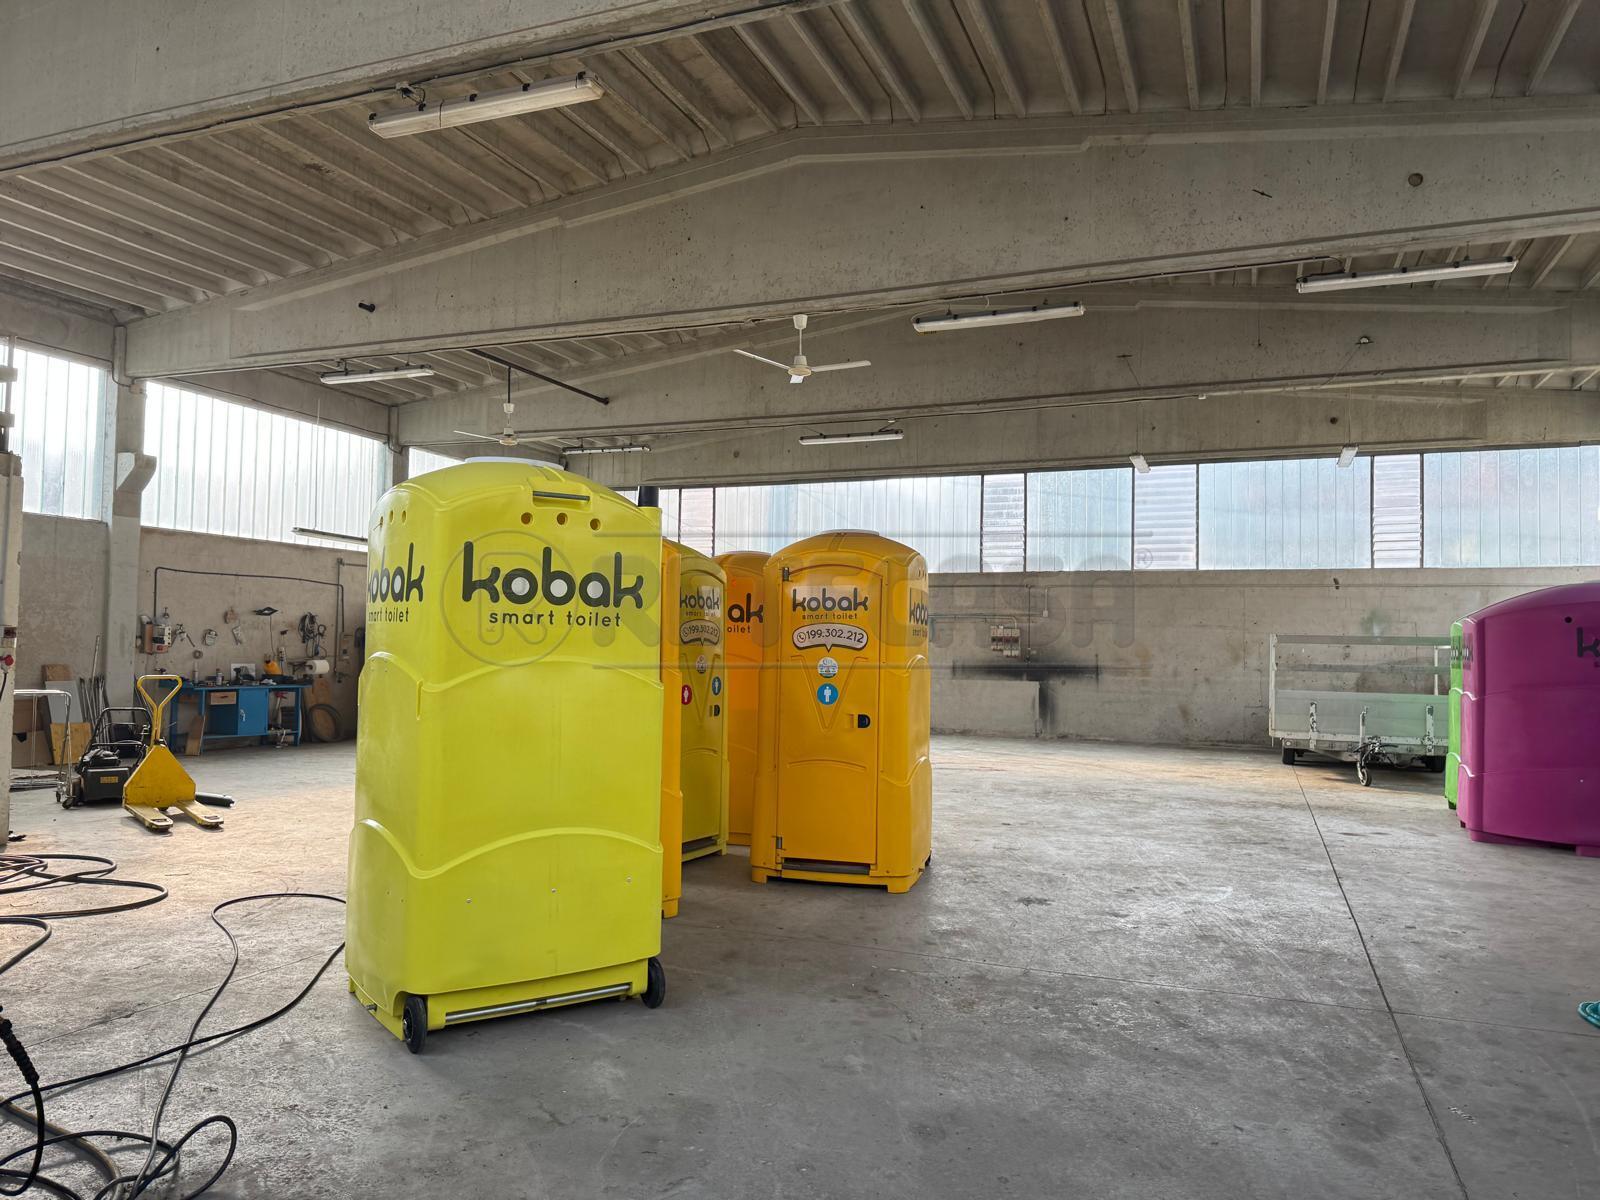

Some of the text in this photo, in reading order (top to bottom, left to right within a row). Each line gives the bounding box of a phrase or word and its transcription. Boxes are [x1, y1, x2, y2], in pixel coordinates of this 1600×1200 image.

[462, 541, 644, 609] kobak
[680, 586, 720, 610] kobak
[792, 587, 869, 612] kobak
[909, 587, 928, 626] koba
[385, 607, 409, 623] toilet
[488, 610, 622, 627] smart toilet
[801, 612, 858, 620] smart toilet
[726, 624, 752, 633] oilet
[805, 628, 865, 643] 199.302.212
